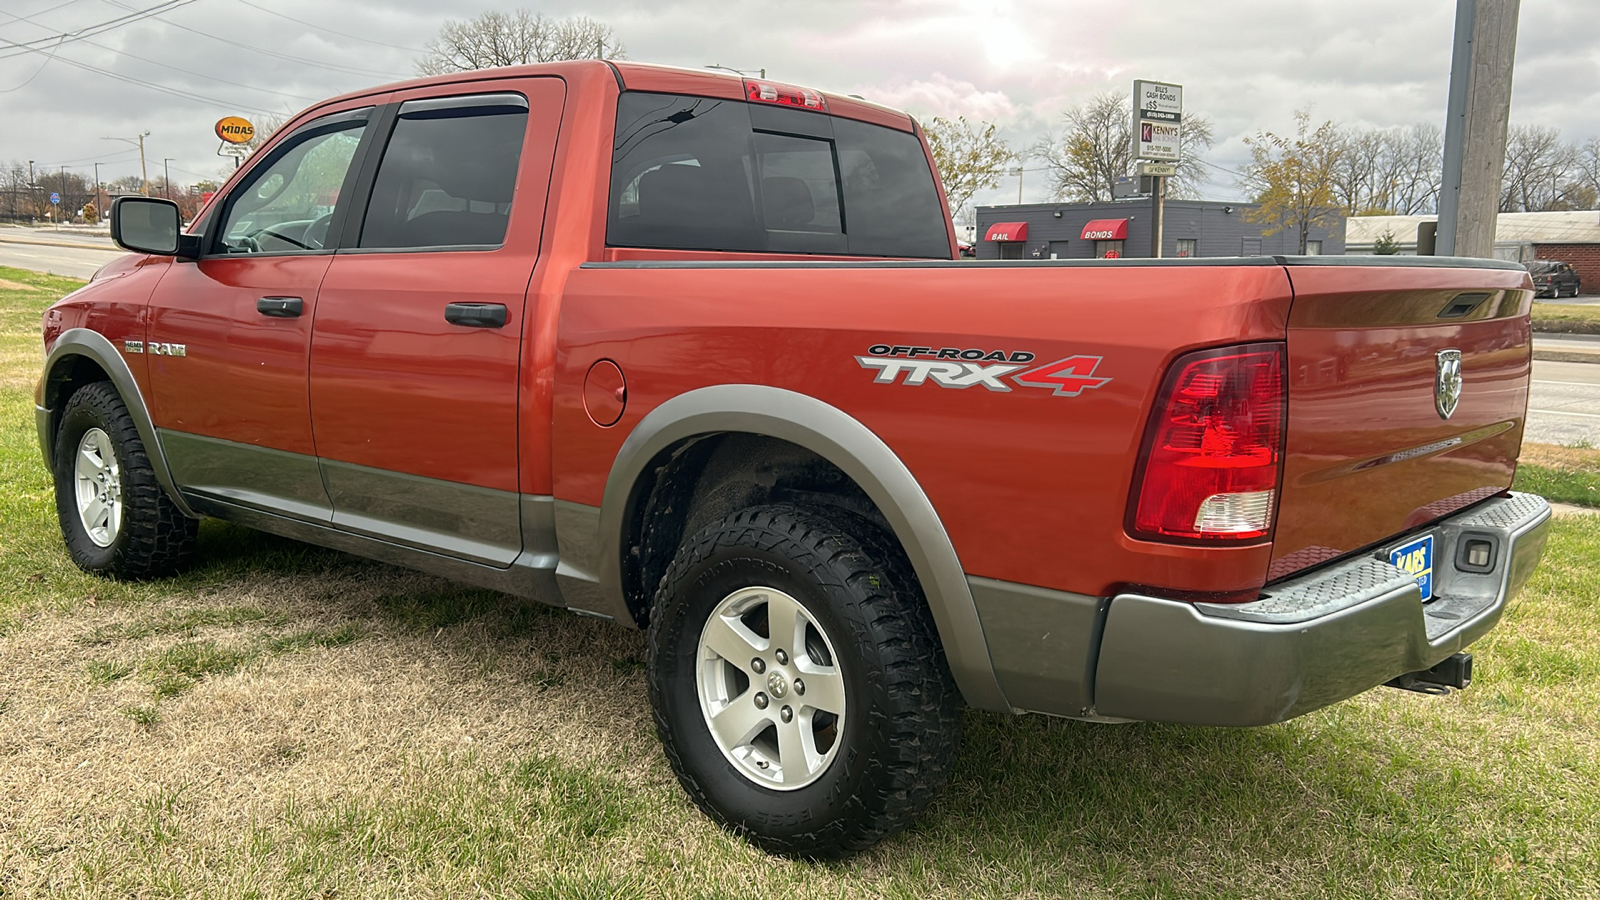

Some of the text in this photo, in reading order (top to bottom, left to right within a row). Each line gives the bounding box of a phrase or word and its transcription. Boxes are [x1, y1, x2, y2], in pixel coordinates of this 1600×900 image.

[1155, 85, 1168, 94] BILL'S
[1146, 91, 1176, 102] CASH BONDS
[221, 125, 253, 135] MIDAS
[1143, 125, 1151, 141] K
[1153, 126, 1178, 136] KENNY'S
[991, 233, 1009, 241] BAIL
[1084, 230, 1113, 239] BONDS
[148, 342, 186, 356] RAM
[868, 344, 1035, 363] OFF-ROAD
